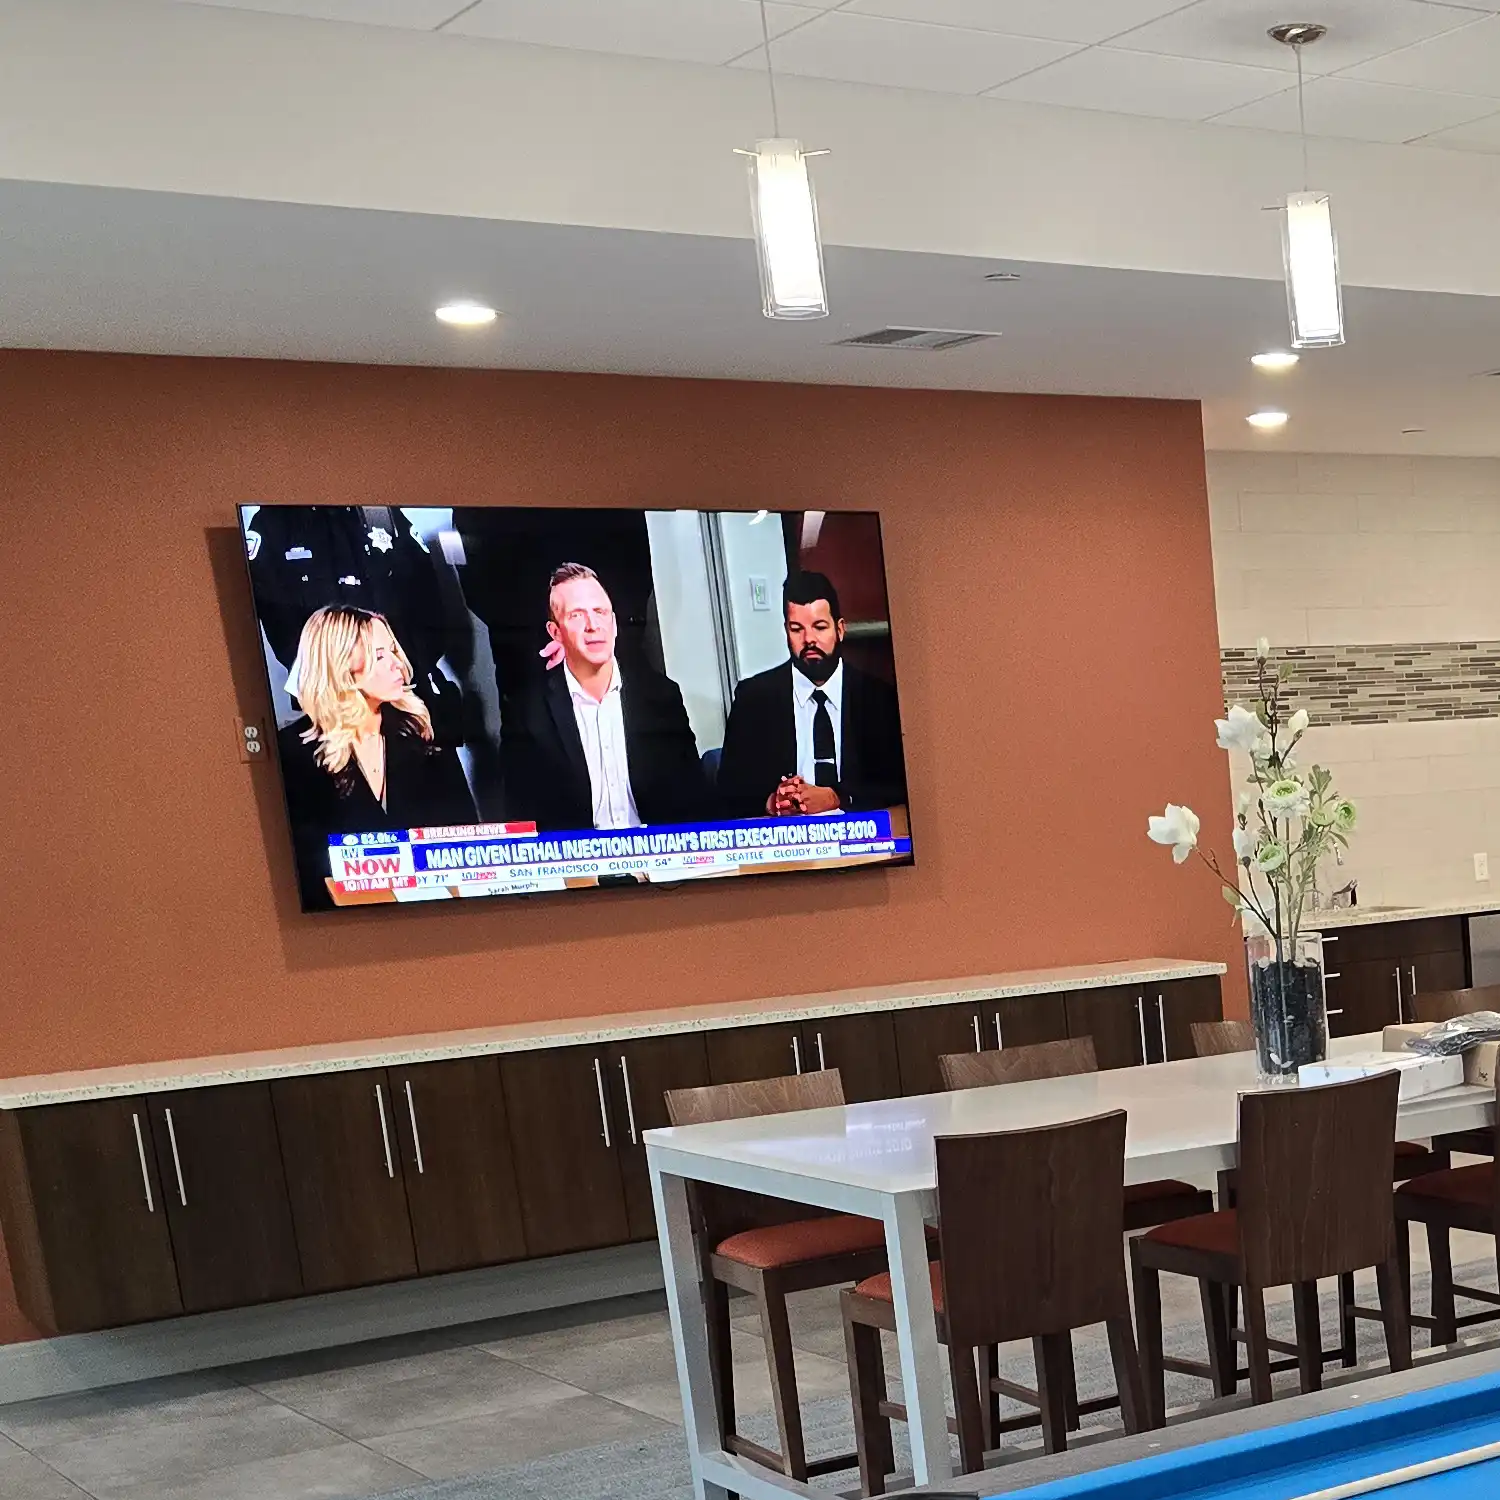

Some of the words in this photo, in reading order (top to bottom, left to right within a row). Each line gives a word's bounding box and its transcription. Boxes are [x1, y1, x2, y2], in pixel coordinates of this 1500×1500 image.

[425, 847, 464, 869] MAN
[464, 844, 511, 867] GIVEN
[511, 840, 562, 863] LETHAL
[562, 836, 633, 860] INJECTION
[633, 834, 650, 855] IN
[650, 831, 699, 854] UTAH'S
[700, 828, 735, 851] FIRST
[735, 824, 808, 847] EXECUTION
[808, 821, 846, 842] SINCE
[846, 819, 877, 840] 2010
[726, 850, 763, 862] SEATTLE
[773, 848, 811, 858] CLOUDY
[343, 857, 401, 877] NOW
[509, 868, 532, 878] SAN
[537, 863, 599, 876] FRANCISCO
[608, 859, 649, 870] CLOUDY
